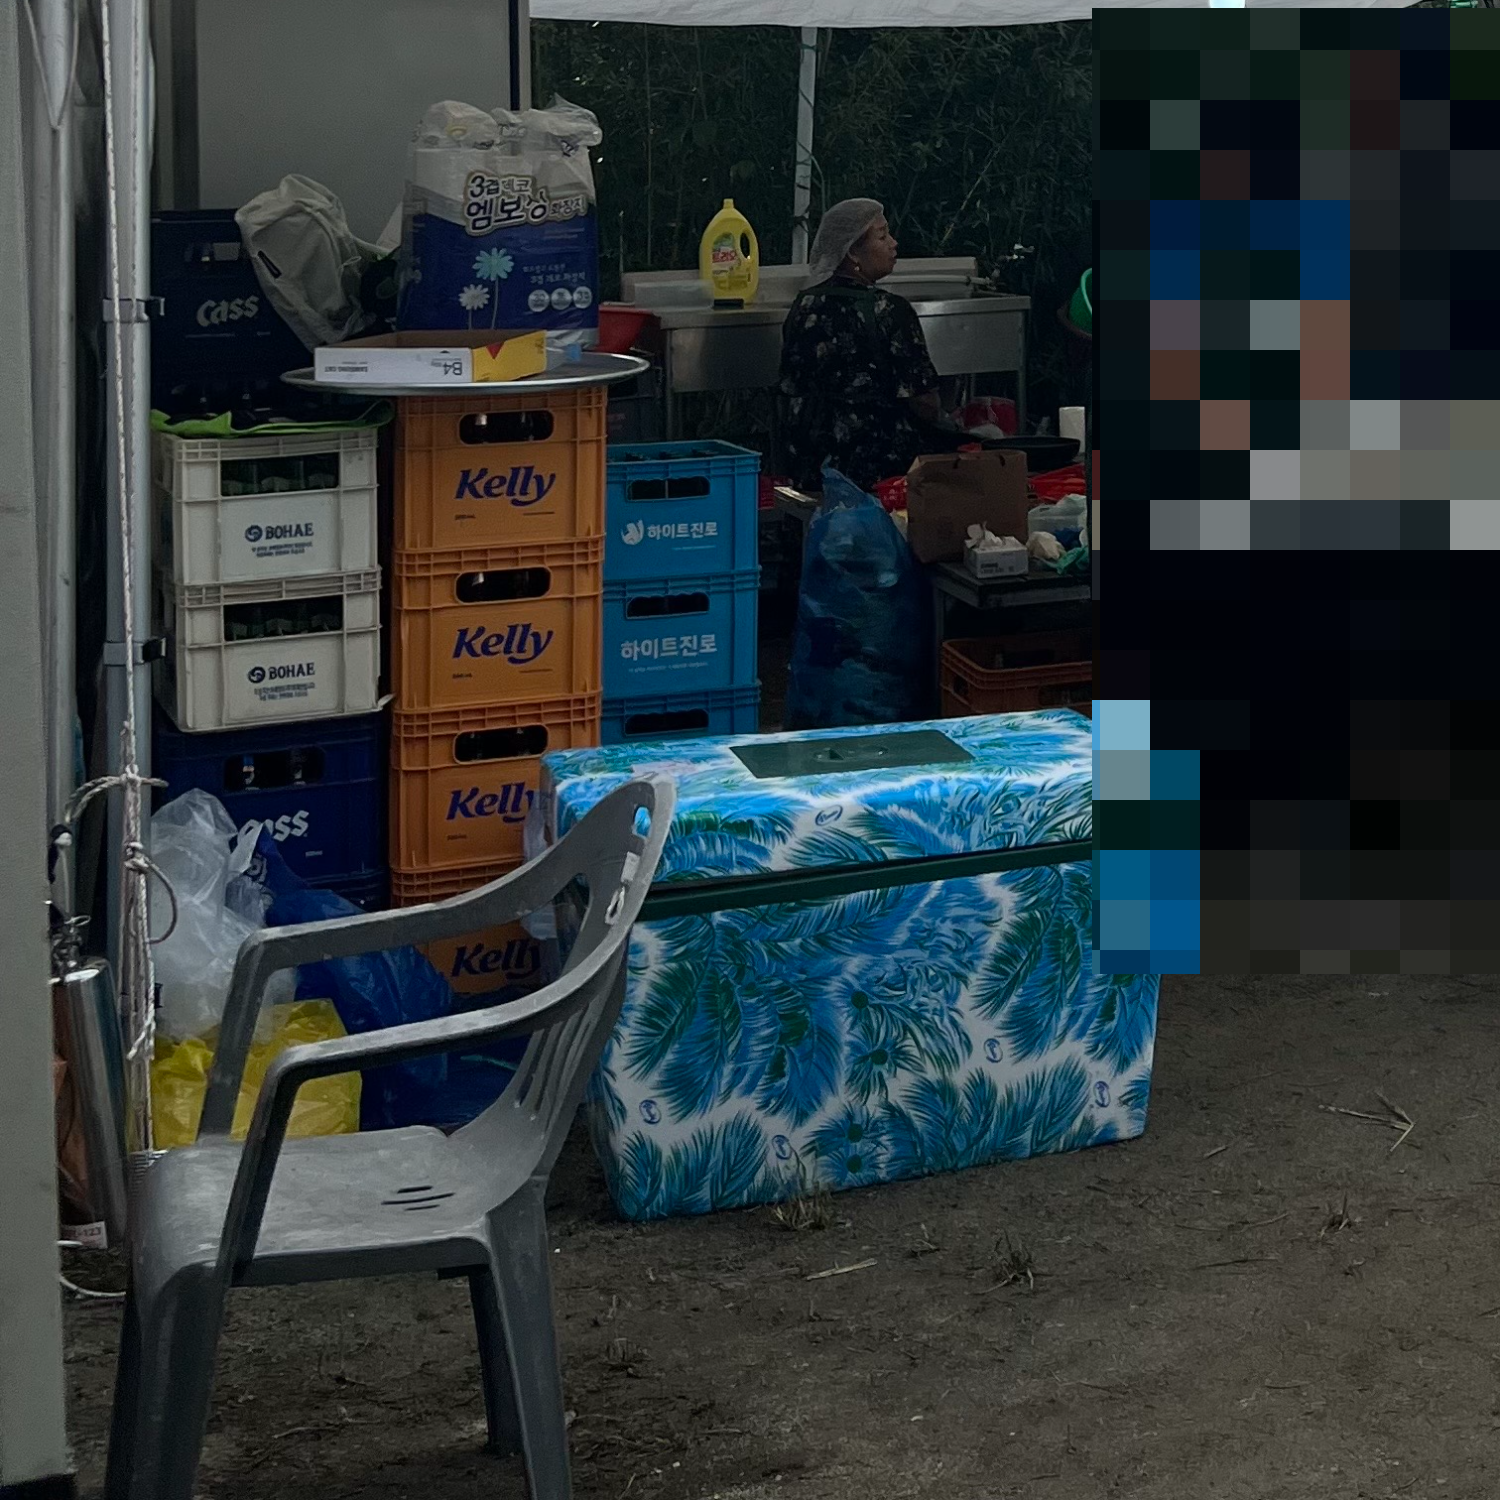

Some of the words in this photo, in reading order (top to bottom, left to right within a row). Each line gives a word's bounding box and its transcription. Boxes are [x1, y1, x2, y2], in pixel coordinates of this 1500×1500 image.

[470, 175, 500, 198] 3겹
[196, 295, 260, 327] Cass
[443, 361, 463, 375] B4
[454, 465, 556, 507] Kelly
[265, 522, 314, 540] BOHAE
[647, 521, 718, 541] 하이트진로
[452, 623, 554, 665] Kelly
[620, 633, 718, 661] 하이트진로
[267, 661, 316, 680] BOHAE
